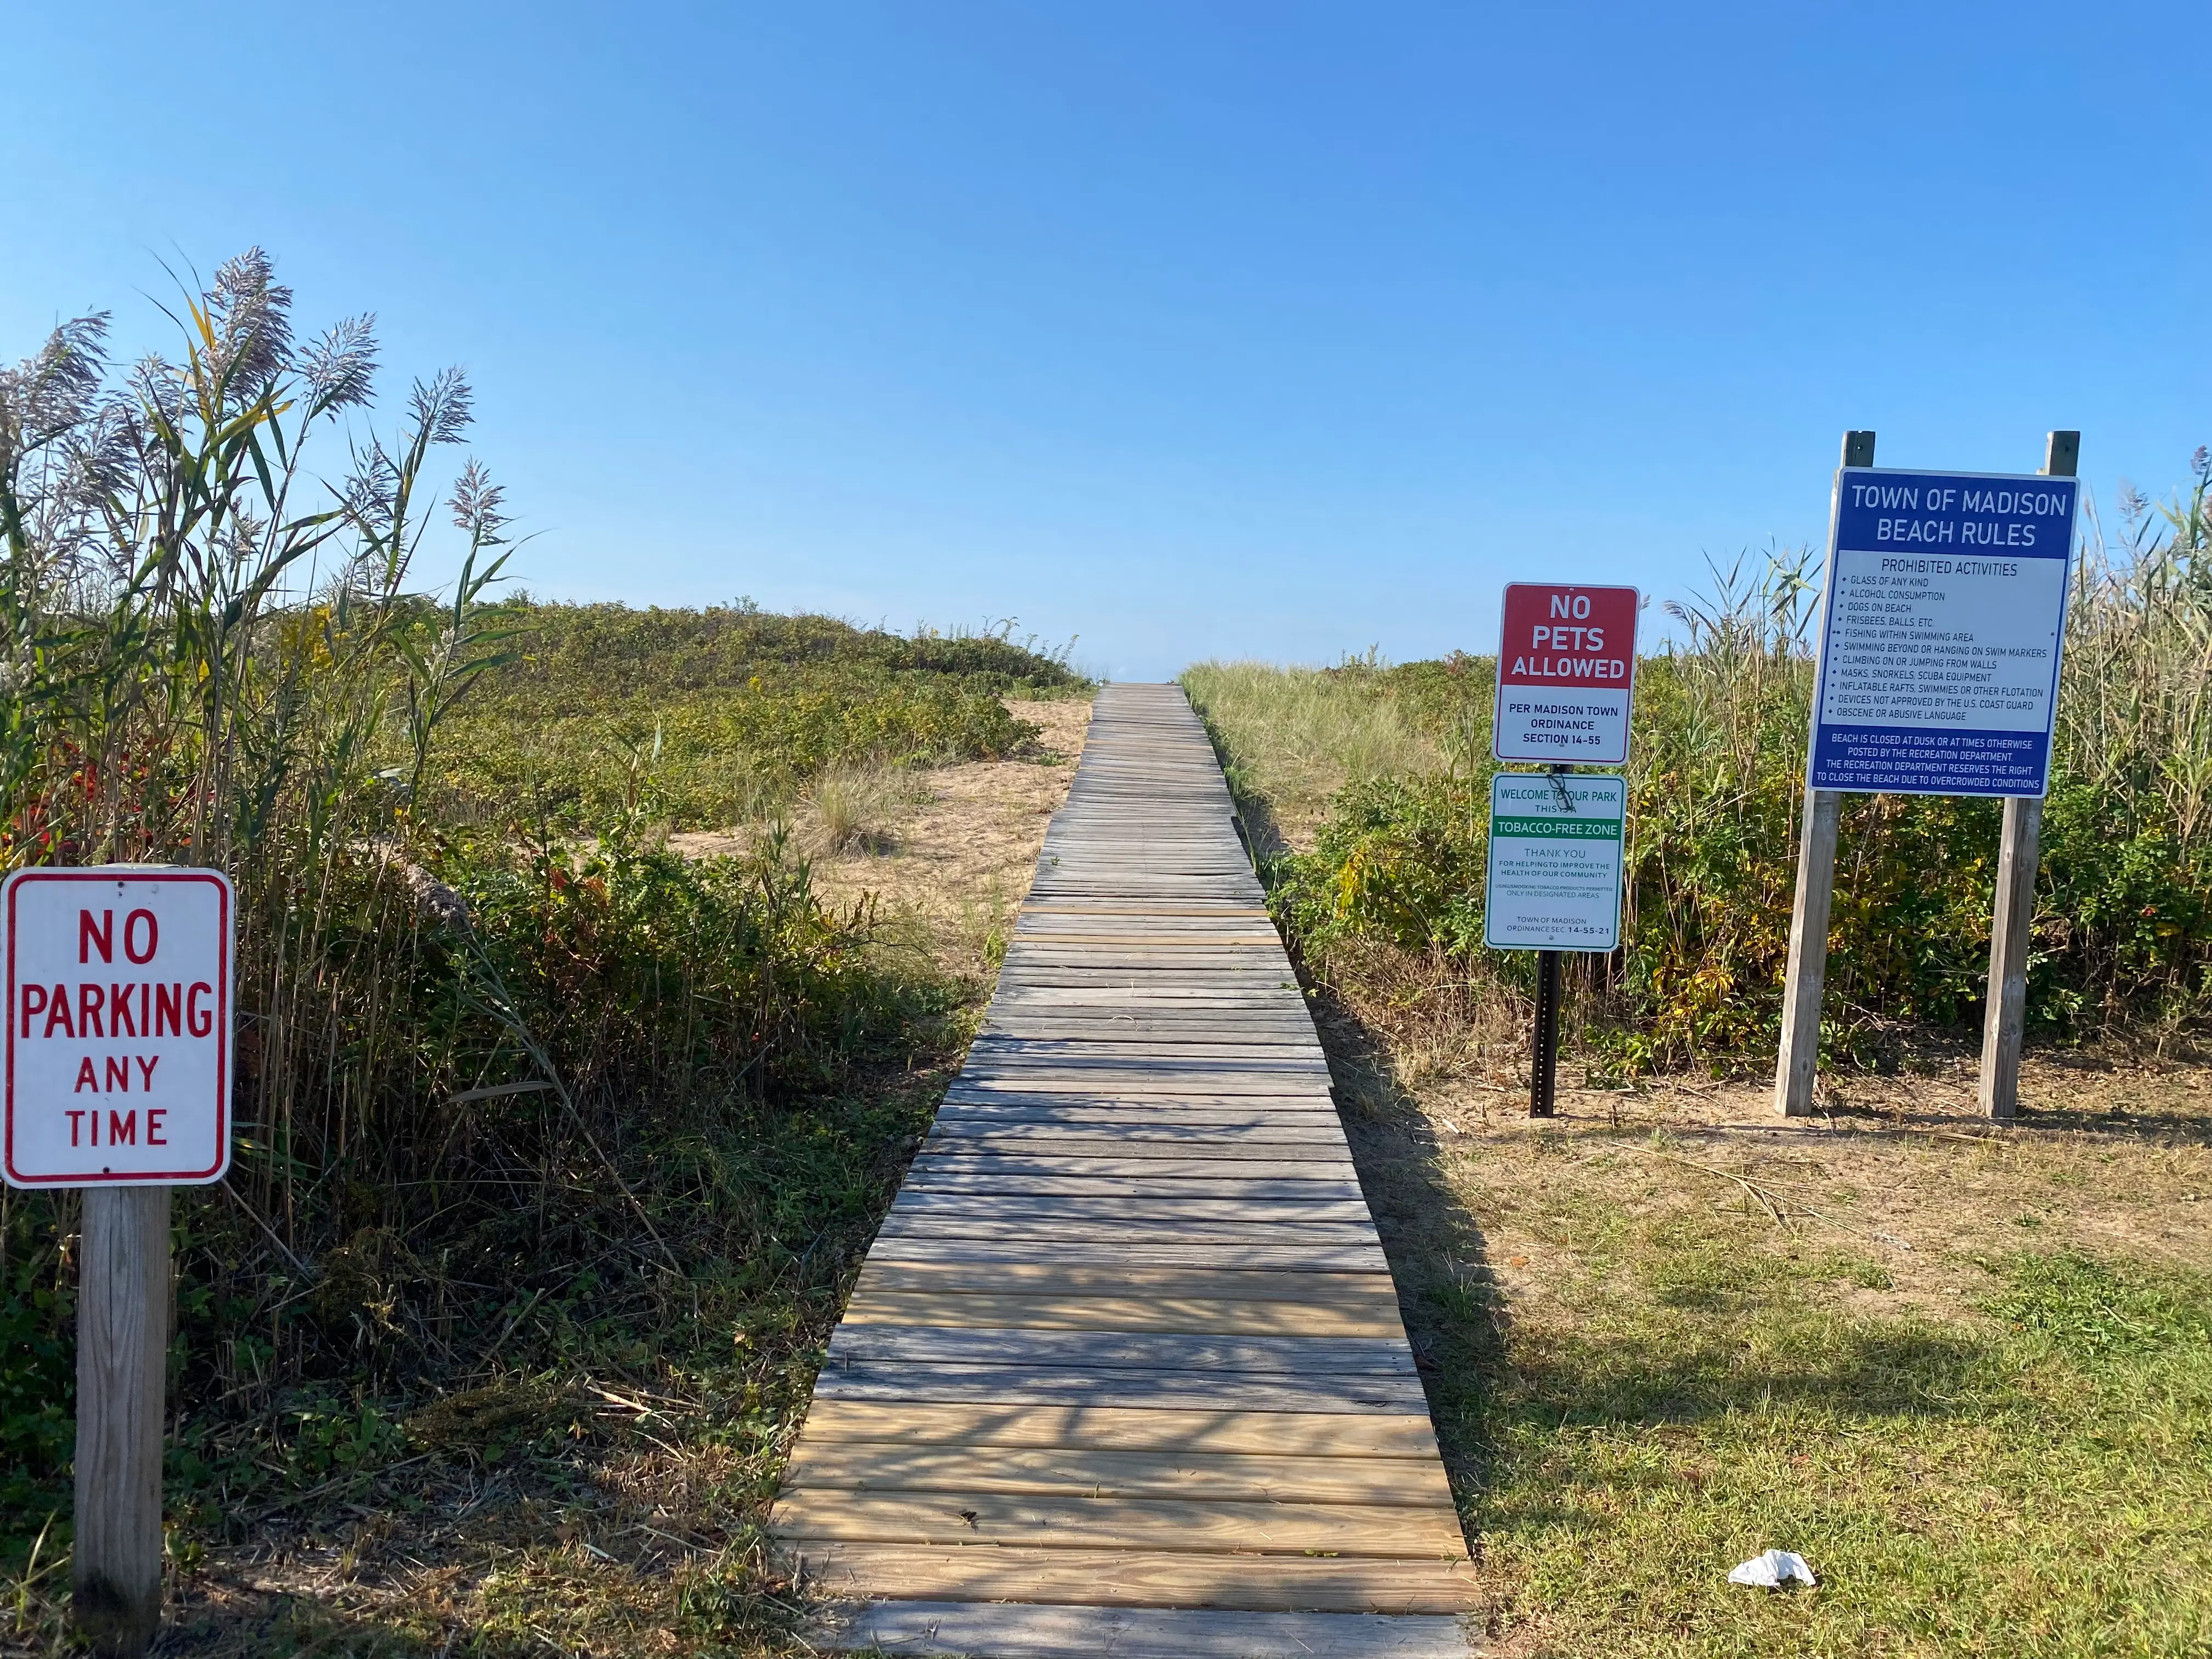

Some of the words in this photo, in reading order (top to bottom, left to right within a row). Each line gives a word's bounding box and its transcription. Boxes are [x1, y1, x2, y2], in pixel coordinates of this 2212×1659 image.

[1852, 486, 1918, 509] TOWN
[1927, 489, 1956, 511] OF
[1963, 490, 2066, 516] MADISON
[1877, 518, 1953, 543] BEACH
[1962, 522, 2035, 546] RULES
[1882, 559, 1951, 573] PROHIBITED
[1955, 562, 2017, 576] ACTIVITIES
[1851, 575, 1876, 584] GLASS
[1879, 577, 1889, 585] OF
[1891, 578, 1908, 586] ANY
[1910, 578, 1928, 586] KIND
[1849, 589, 1886, 598] ALCOHOL
[1889, 590, 1945, 601] CONSUMPTION
[1550, 595, 1590, 619] NO
[1848, 602, 1869, 611] DOGS
[1885, 604, 1911, 613] BEACH
[1847, 616, 1886, 625] FRISBEES,
[1889, 617, 1916, 627] BALLS,
[1533, 626, 1604, 651] PETS
[1846, 629, 1876, 637] FISHING
[1880, 630, 1907, 639] WITHIN
[1910, 631, 1950, 641] SWIMMING
[1953, 633, 1973, 642] AREA
[1844, 642, 1885, 651] SWIMMING
[1888, 644, 1918, 653] BEYOND
[1921, 645, 1931, 653] OR
[1934, 646, 1969, 654] HANGING
[1972, 647, 1983, 655] ON
[1985, 647, 2006, 656] SWIM
[2008, 648, 2046, 657] MARKERS
[1511, 657, 1624, 678] ALLOWED
[1843, 655, 1880, 664] CLIMBING
[1897, 657, 1906, 665] OR
[1909, 658, 1944, 667] JUMPING
[1946, 659, 1968, 668] FROM
[1971, 660, 1996, 669] WALLS
[1841, 669, 1869, 678] MASKS,
[1872, 669, 1915, 679] SNORKELS,
[1918, 672, 1943, 680] SCUBA
[1946, 673, 1991, 681] EQUIPMENT
[1840, 681, 1887, 691] INFLATABLE
[1890, 684, 1915, 692] RAFTS,
[1918, 685, 1958, 693] SWIMMIES
[1961, 686, 1971, 695] OR
[1974, 687, 1999, 695] OTHER
[2002, 687, 2043, 697] FLOTATION
[1510, 704, 1530, 713] PER
[1534, 704, 1583, 715] MADISON
[1587, 707, 1617, 716] TOWN
[1838, 695, 1871, 703] DEVICES
[1891, 697, 1932, 706] APPROVED
[1947, 699, 1962, 707] THE
[1964, 699, 1977, 708] U.S.
[1980, 700, 2005, 708] COAST
[2007, 701, 2033, 710] GUARD
[1837, 708, 1874, 717] OBSCENE
[1889, 710, 1922, 719] ABUSIVE
[1925, 711, 1966, 720] LANGUAGE
[1531, 719, 1594, 730] ORDINANCE
[1523, 733, 1568, 743] SECTION
[1573, 735, 1600, 744] 14-55
[1832, 733, 1858, 742] BEACH
[1860, 735, 1867, 743] IS
[1870, 735, 1900, 744] CLOSED
[1902, 736, 1912, 744] AT
[1914, 737, 1935, 745] DUSK
[1938, 737, 1948, 746] OR
[1950, 738, 1960, 746] AT
[1962, 738, 1985, 747] TIMES
[1988, 739, 2033, 749] OTHERWISE
[1848, 747, 1878, 756] POSTED
[1880, 748, 1891, 757] BY
[1892, 749, 1907, 758] THE
[1909, 749, 1957, 759] RECREATION
[1960, 752, 2012, 761] DEPARTMENT.
[1826, 759, 1842, 768] THE
[1844, 760, 1892, 770] RECREATION
[1895, 762, 1947, 772] DEPARTMENT
[1949, 764, 1989, 773] RESERVES
[1992, 765, 2007, 774] THE
[2009, 766, 2033, 775] RIGHT
[1817, 772, 1826, 780] TO
[1829, 772, 1854, 781] CLOSE
[1856, 774, 1871, 782] THE
[1874, 774, 1899, 783] BEACH
[1901, 775, 1917, 783] DUE
[1919, 776, 1928, 784] TO
[1931, 776, 1990, 786] OVERCROWDED
[1993, 778, 2039, 788] CONDITIONS
[1500, 789, 1549, 799] WELCOME
[1551, 790, 1565, 800] TO
[1568, 791, 1588, 801] OUR
[1592, 792, 1617, 802] PARK
[1498, 822, 1582, 834] TOBACCO-FREE
[1585, 825, 1617, 836] ZONE
[1525, 848, 1561, 857] THANK
[1564, 850, 1585, 859] YOU
[79, 909, 158, 964] NO
[21, 982, 211, 1038] PARKING
[75, 1056, 159, 1092] ANY
[65, 1109, 167, 1147] TIME
